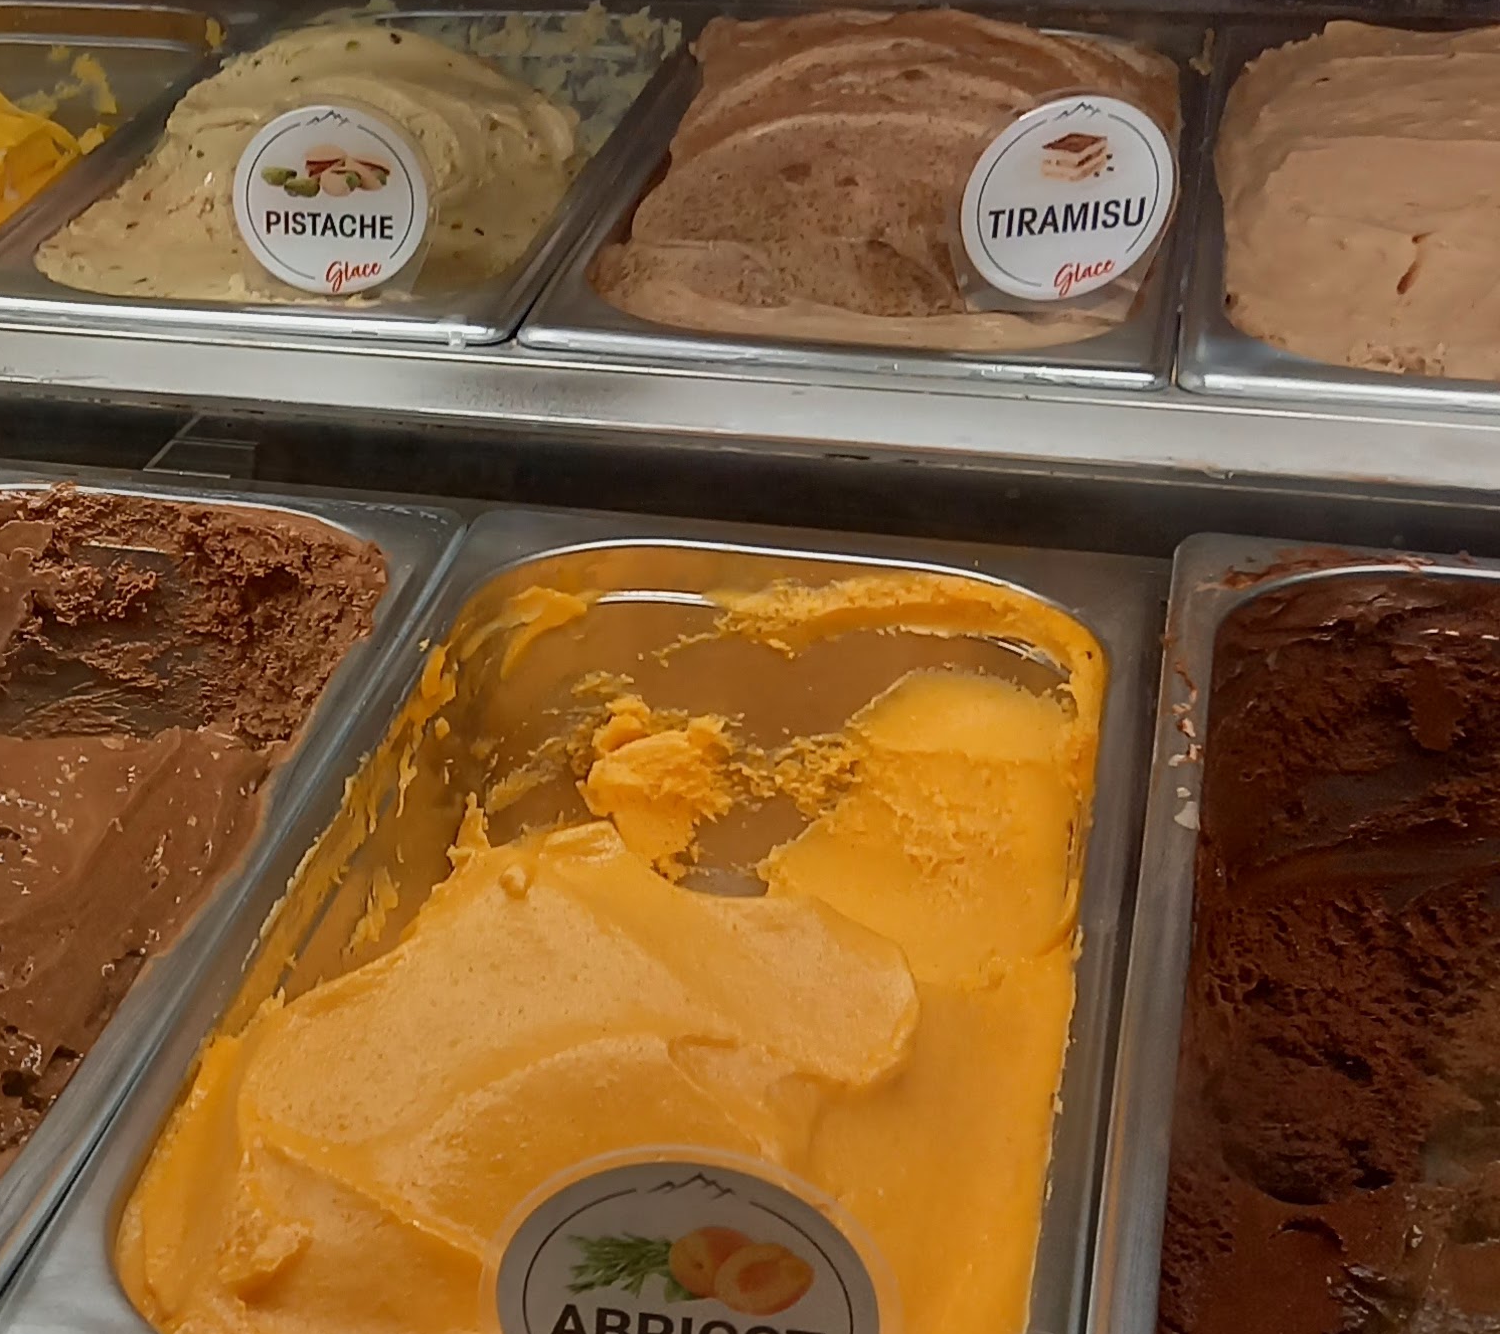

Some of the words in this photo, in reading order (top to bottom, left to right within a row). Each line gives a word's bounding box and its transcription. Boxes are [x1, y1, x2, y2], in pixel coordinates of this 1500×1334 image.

[265, 210, 393, 240] PISTACHE
[988, 196, 1147, 239] TIRAMISU
[325, 260, 382, 293] Glace
[1053, 259, 1116, 297] Glace
